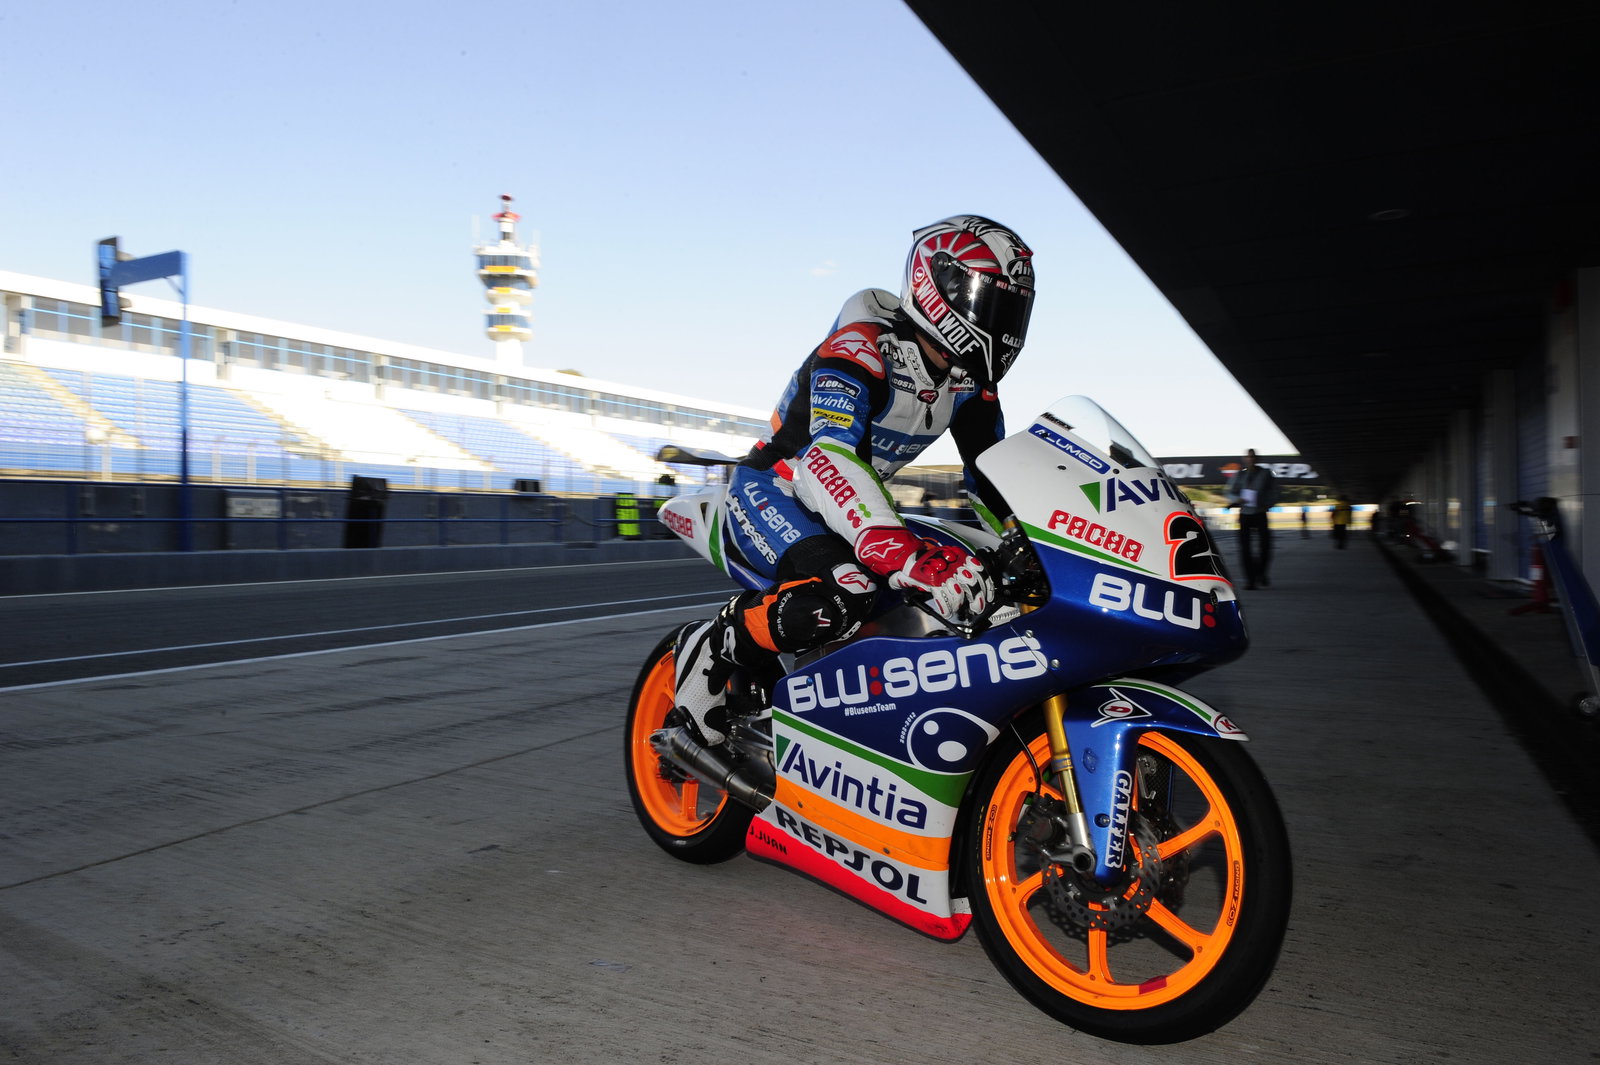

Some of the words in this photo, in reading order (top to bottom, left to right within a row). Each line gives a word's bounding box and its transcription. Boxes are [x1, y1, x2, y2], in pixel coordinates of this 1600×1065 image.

[915, 276, 948, 323] WILD
[938, 312, 980, 357] WOLF
[812, 394, 856, 412] Avintia
[806, 446, 855, 508] PACHA
[1034, 429, 1103, 470] ALUMED
[1047, 509, 1144, 563] PACHA
[844, 702, 897, 717] #BlusensTeam
[782, 742, 928, 830] Avintia
[748, 825, 788, 856] J.JUAN
[1107, 772, 1132, 868] GALFER
[775, 805, 928, 906] REPSOL
